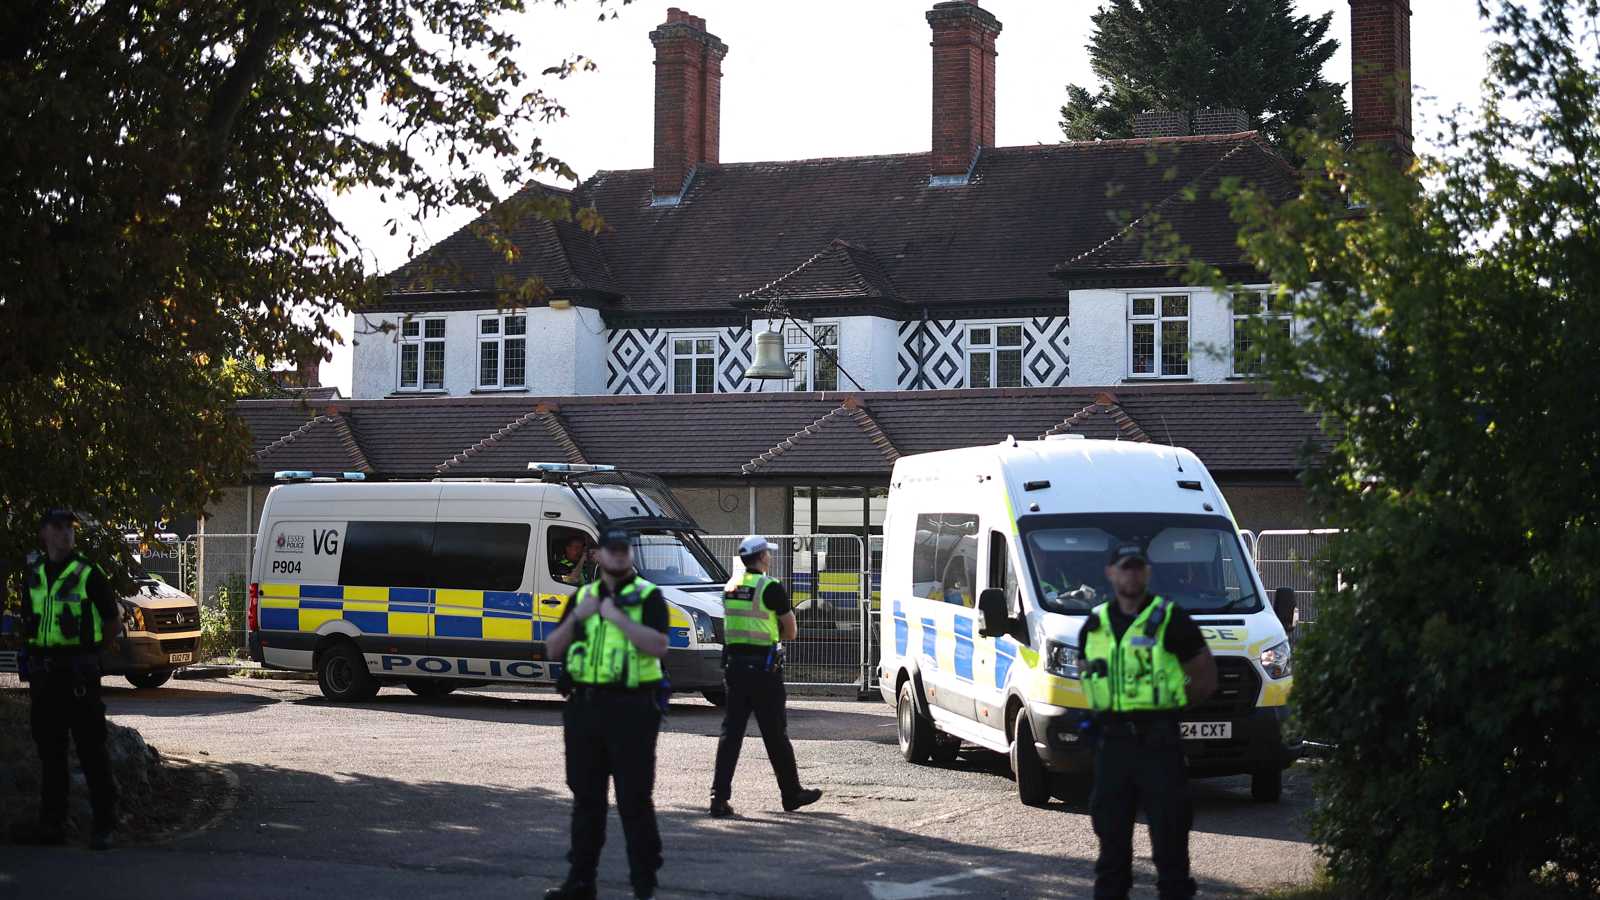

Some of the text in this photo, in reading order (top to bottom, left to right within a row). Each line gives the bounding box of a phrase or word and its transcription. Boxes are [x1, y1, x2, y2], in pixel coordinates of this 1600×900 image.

[313, 529, 338, 555] VG
[272, 560, 301, 573] P904
[1181, 724, 1226, 737] 24 CXT
